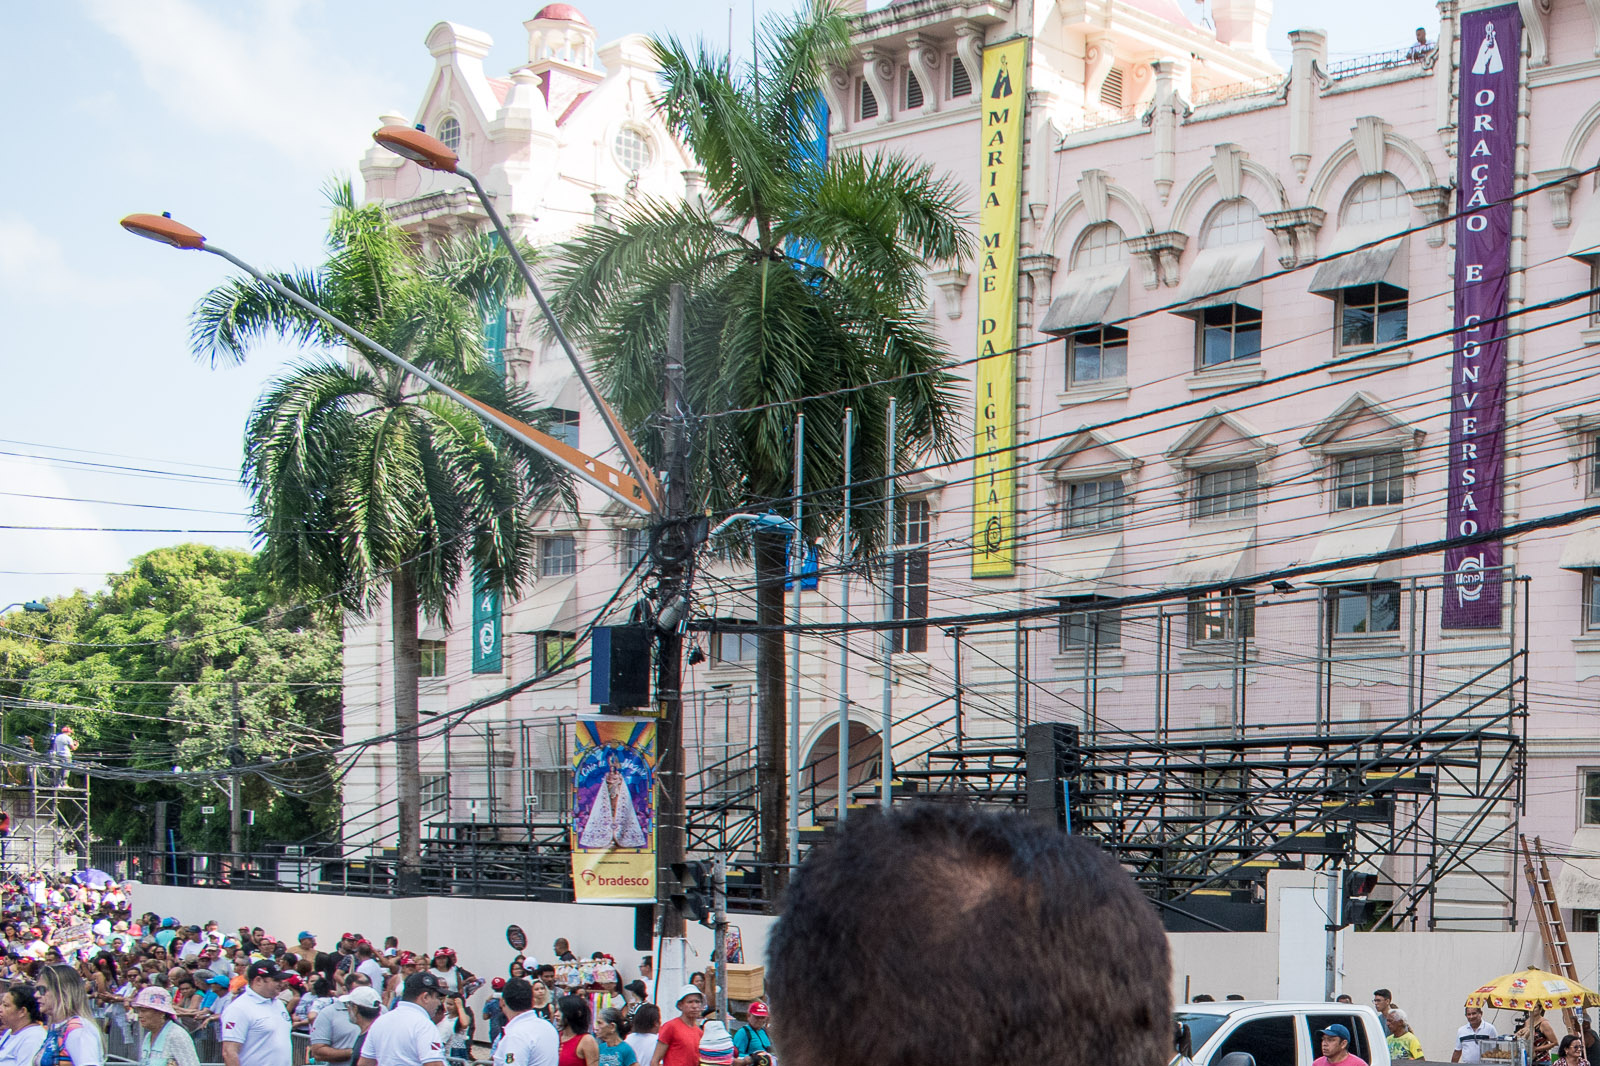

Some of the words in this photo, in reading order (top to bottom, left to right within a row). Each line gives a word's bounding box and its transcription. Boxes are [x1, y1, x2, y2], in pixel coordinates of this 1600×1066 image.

[984, 109, 1009, 208] MARIA
[1466, 89, 1495, 232] ORAÇÃO
[982, 233, 1001, 293] MÃE
[1465, 264, 1482, 283] E
[980, 318, 997, 357] DA
[985, 382, 999, 505] IGREJA
[1459, 314, 1481, 537] CONVERSÃO
[598, 875, 649, 886] bradesco
